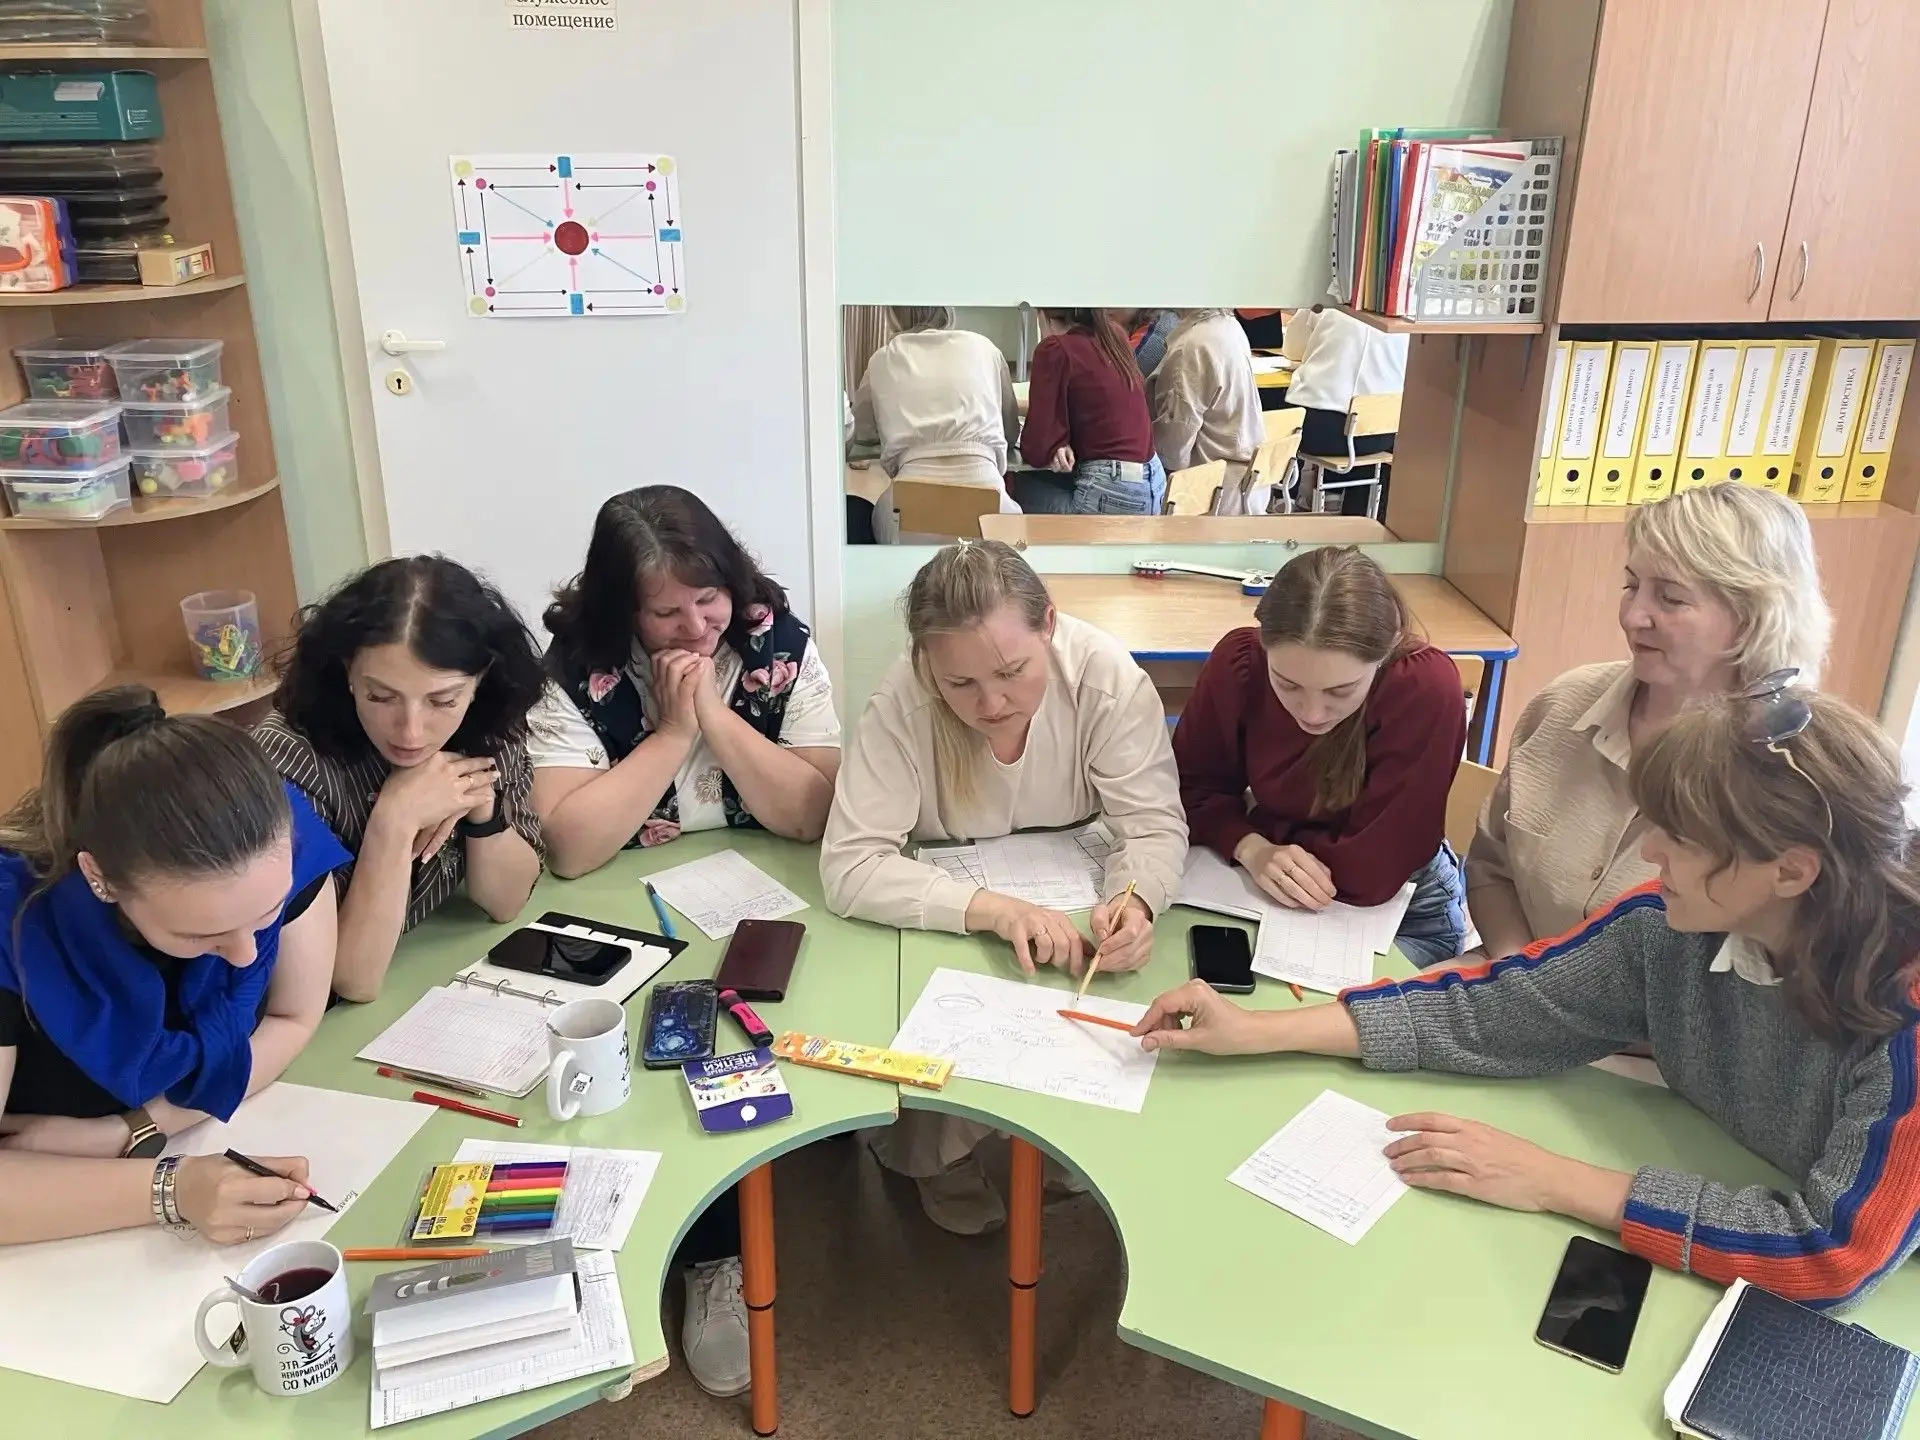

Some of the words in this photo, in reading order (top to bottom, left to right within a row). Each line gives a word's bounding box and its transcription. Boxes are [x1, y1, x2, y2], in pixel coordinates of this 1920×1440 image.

[513, 14, 614, 30] помещение
[1617, 400, 1631, 437] Обучение
[1626, 368, 1636, 398] грамоте
[1836, 368, 1856, 434] ДИАГНОСТИКА
[1651, 401, 1664, 439] Картотека
[703, 1054, 757, 1072] МЕЛКИ
[706, 1061, 759, 1076] ВОСКОВЫЕ
[279, 1360, 299, 1371] ЭТА
[281, 1353, 336, 1379] НЕНОРМАЛЬНАЯ
[282, 1379, 298, 1390] СО
[303, 1362, 338, 1388] МНОЙ
